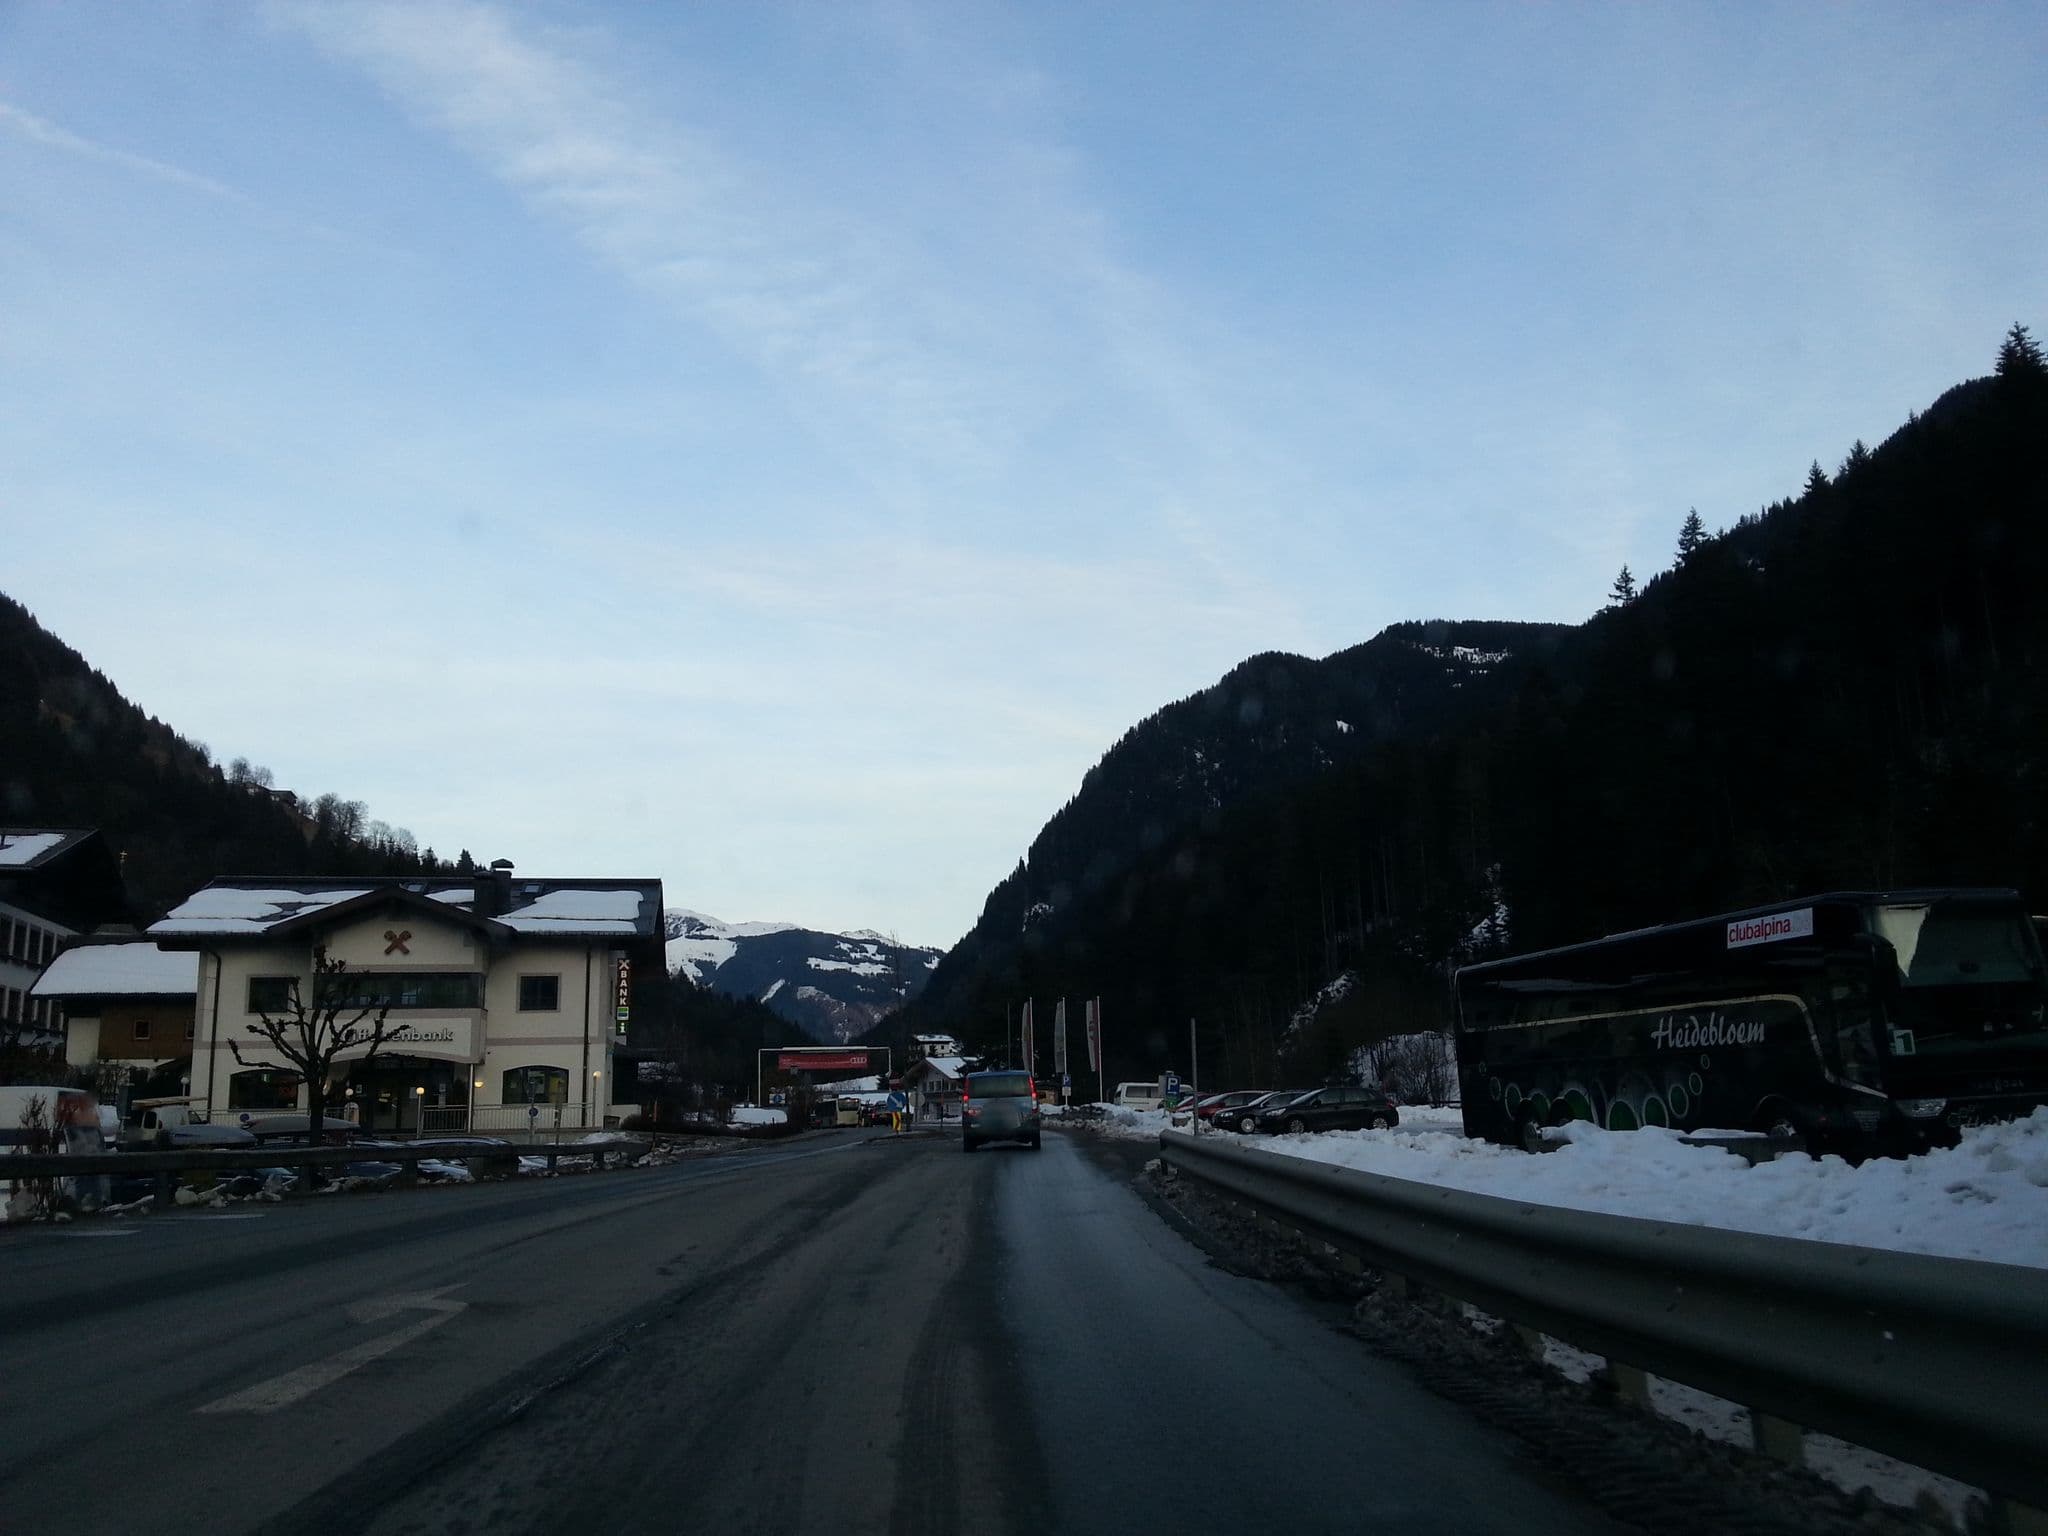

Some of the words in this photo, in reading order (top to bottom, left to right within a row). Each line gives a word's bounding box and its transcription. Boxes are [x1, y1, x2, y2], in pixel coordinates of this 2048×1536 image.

[1728, 917, 1791, 943] clubalpina
[618, 970, 628, 1005] BANK
[335, 1027, 453, 1041] iffenbank
[1651, 1011, 1765, 1049] Heidebloem
[1167, 1077, 1178, 1091] P
